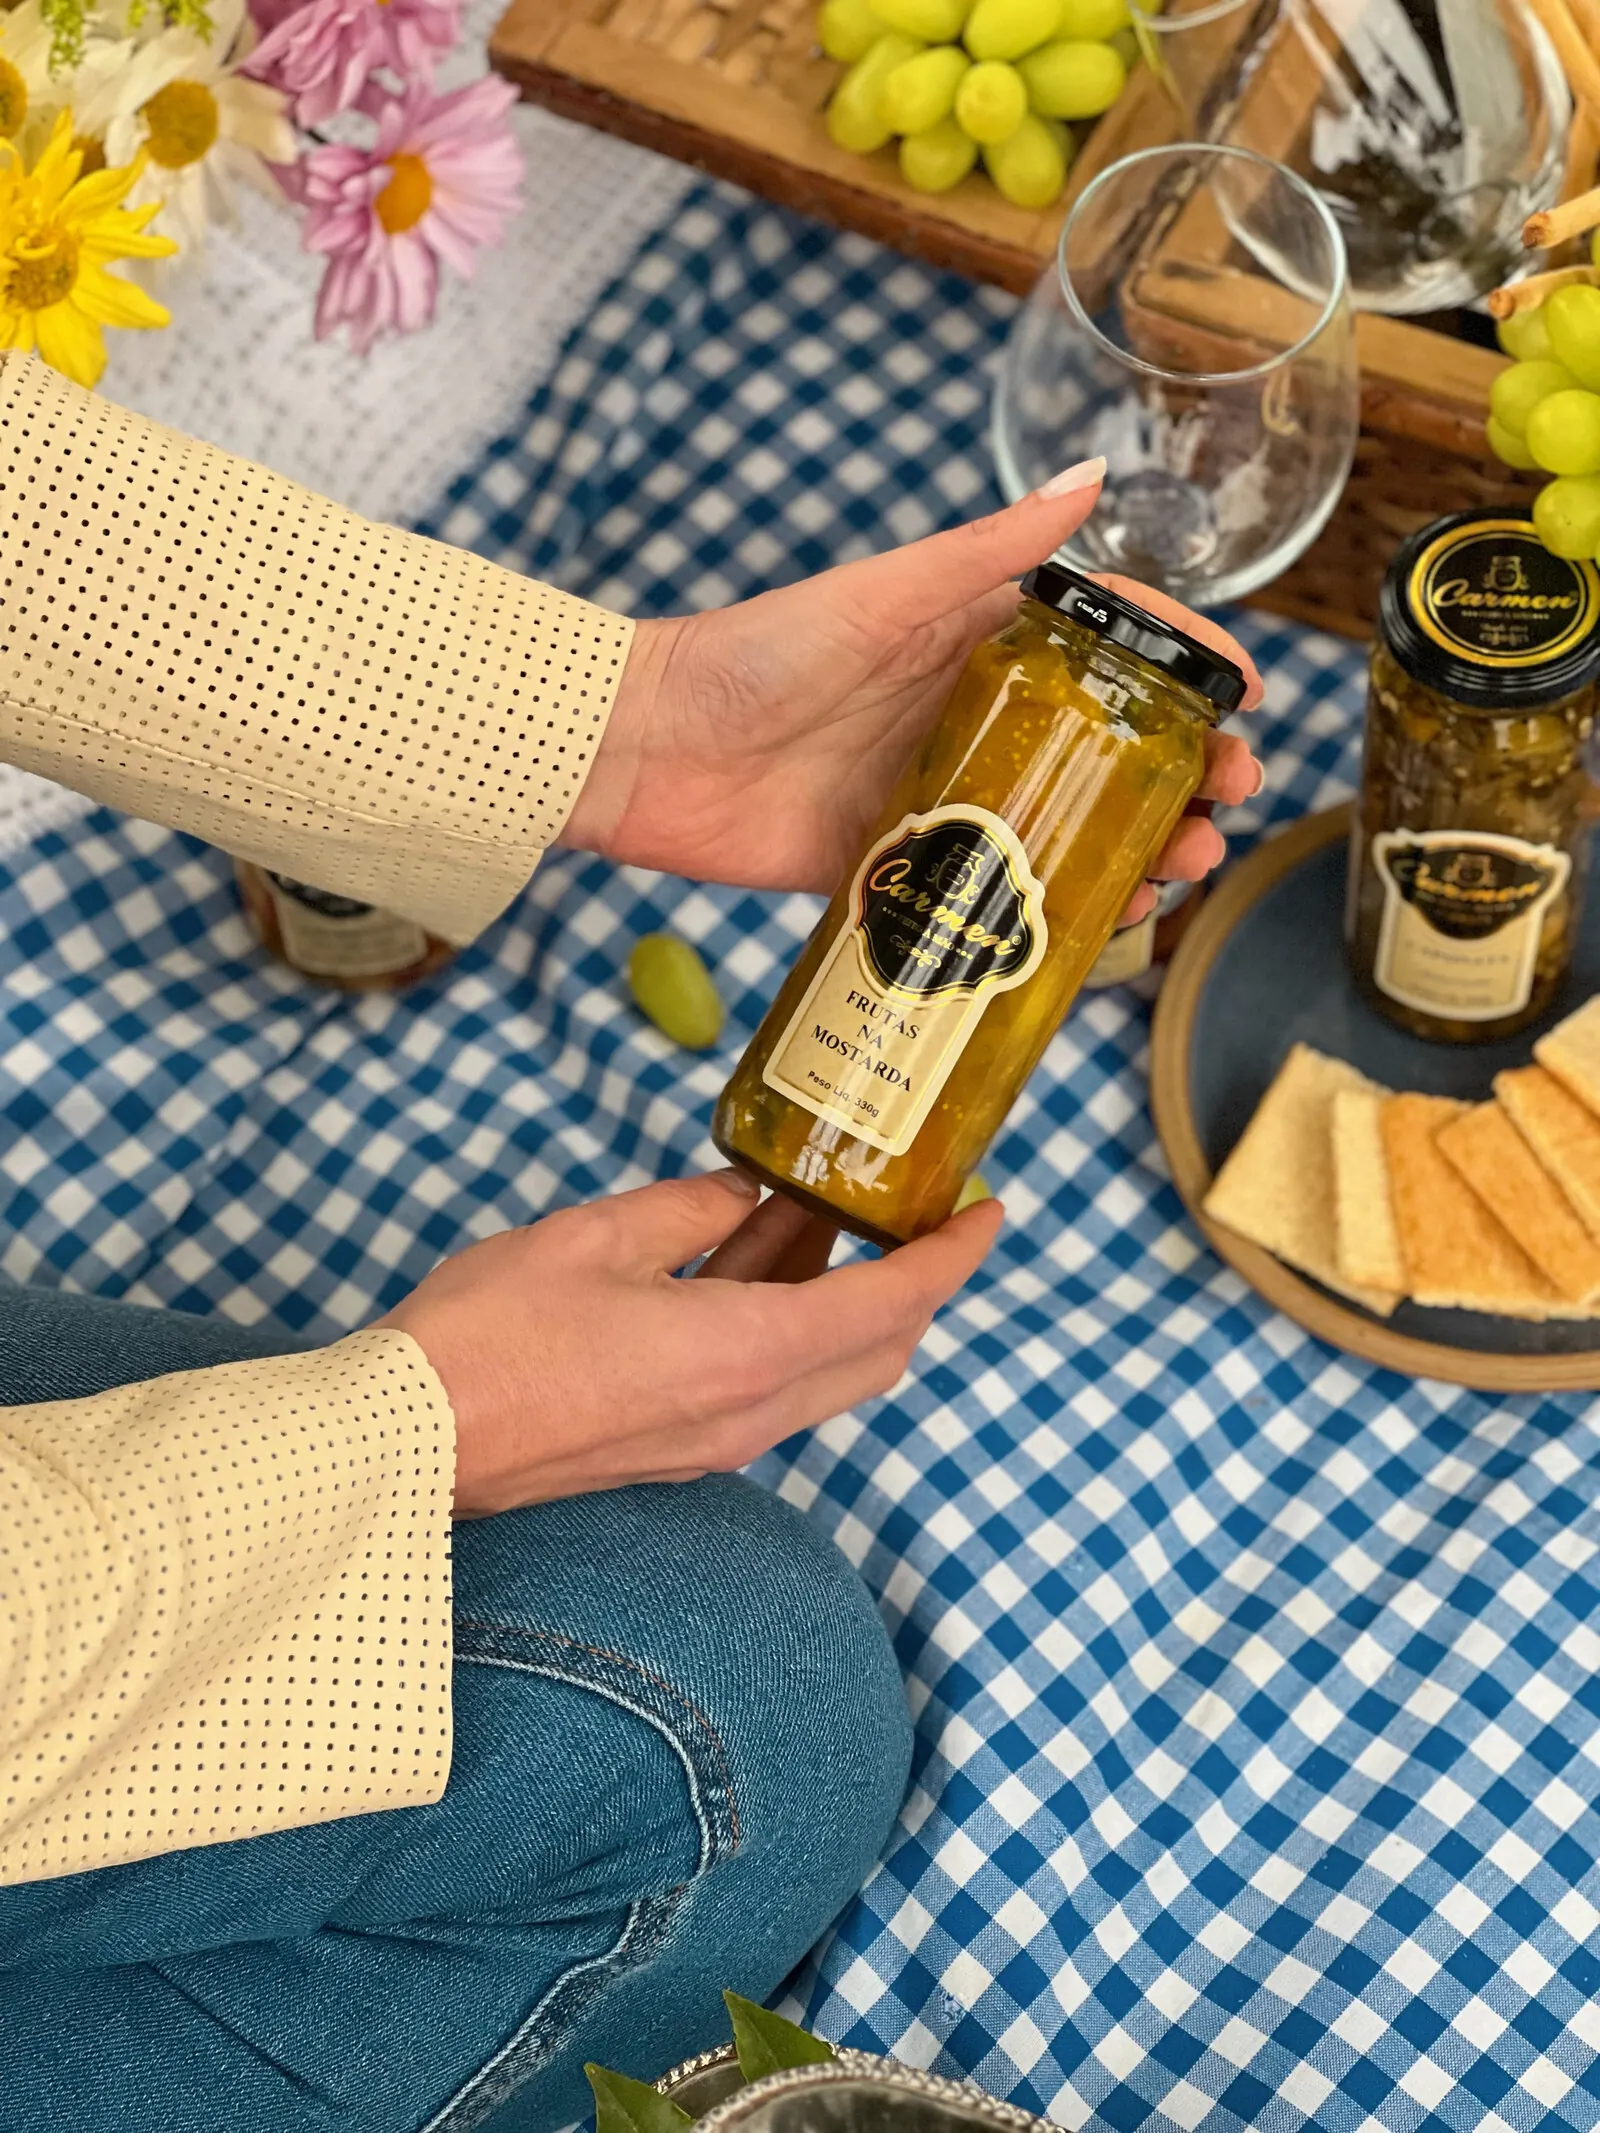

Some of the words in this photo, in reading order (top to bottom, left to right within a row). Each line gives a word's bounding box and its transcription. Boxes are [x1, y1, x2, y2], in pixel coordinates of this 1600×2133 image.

[1432, 578, 1577, 609] Carmen
[869, 858, 1016, 956] Carmen
[845, 990, 920, 1039] FRUTAS
[857, 1024, 882, 1050] NA
[811, 1024, 912, 1092] MOSTARDA
[808, 1070, 831, 1090] Peso
[854, 1097, 879, 1118] 330g
